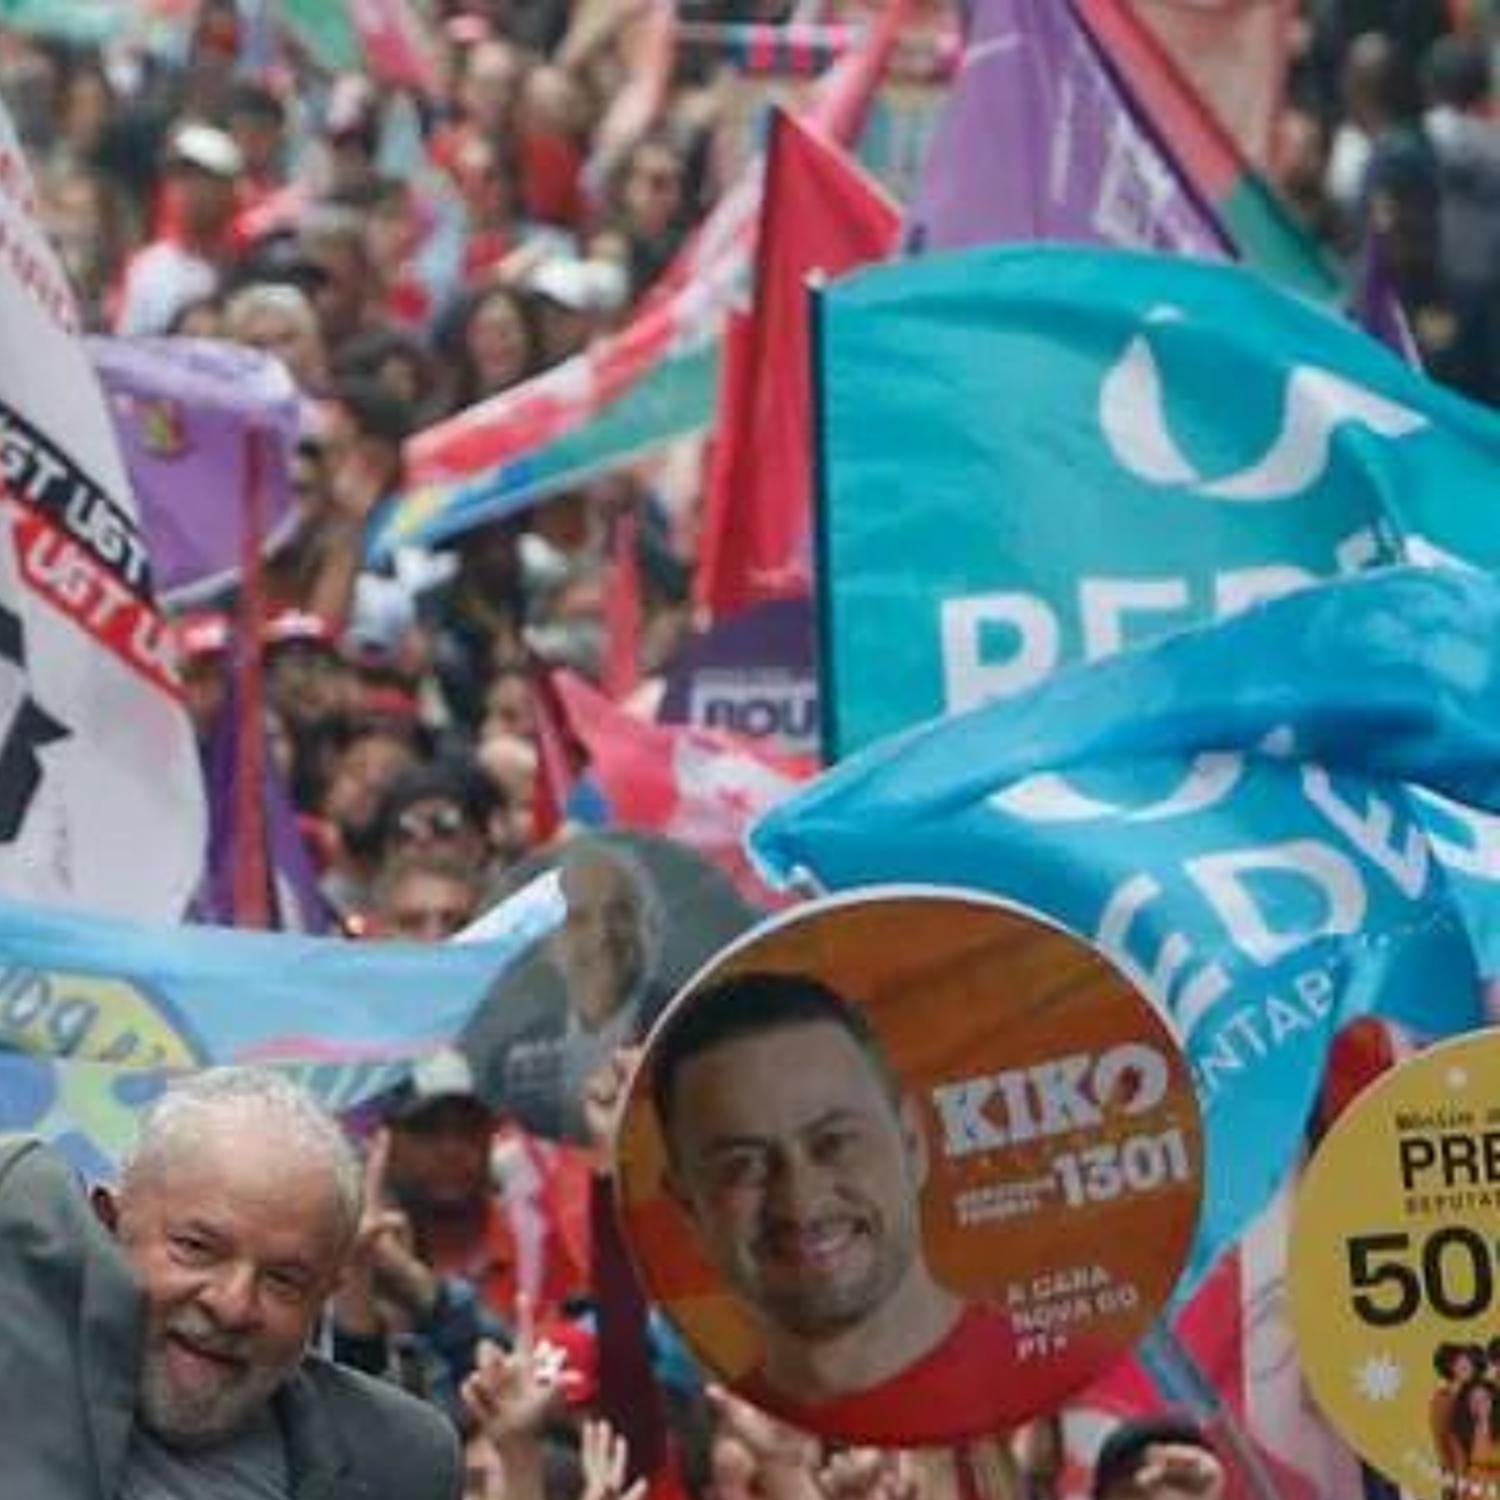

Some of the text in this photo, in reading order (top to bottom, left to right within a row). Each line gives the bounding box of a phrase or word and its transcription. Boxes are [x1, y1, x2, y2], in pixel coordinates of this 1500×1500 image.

[24, 527, 142, 626] UGT
[64, 486, 150, 584] UGT
[932, 1043, 1169, 1157] KIKO
[1053, 1128, 1190, 1206] 1301
[1346, 1224, 1500, 1330] 50
